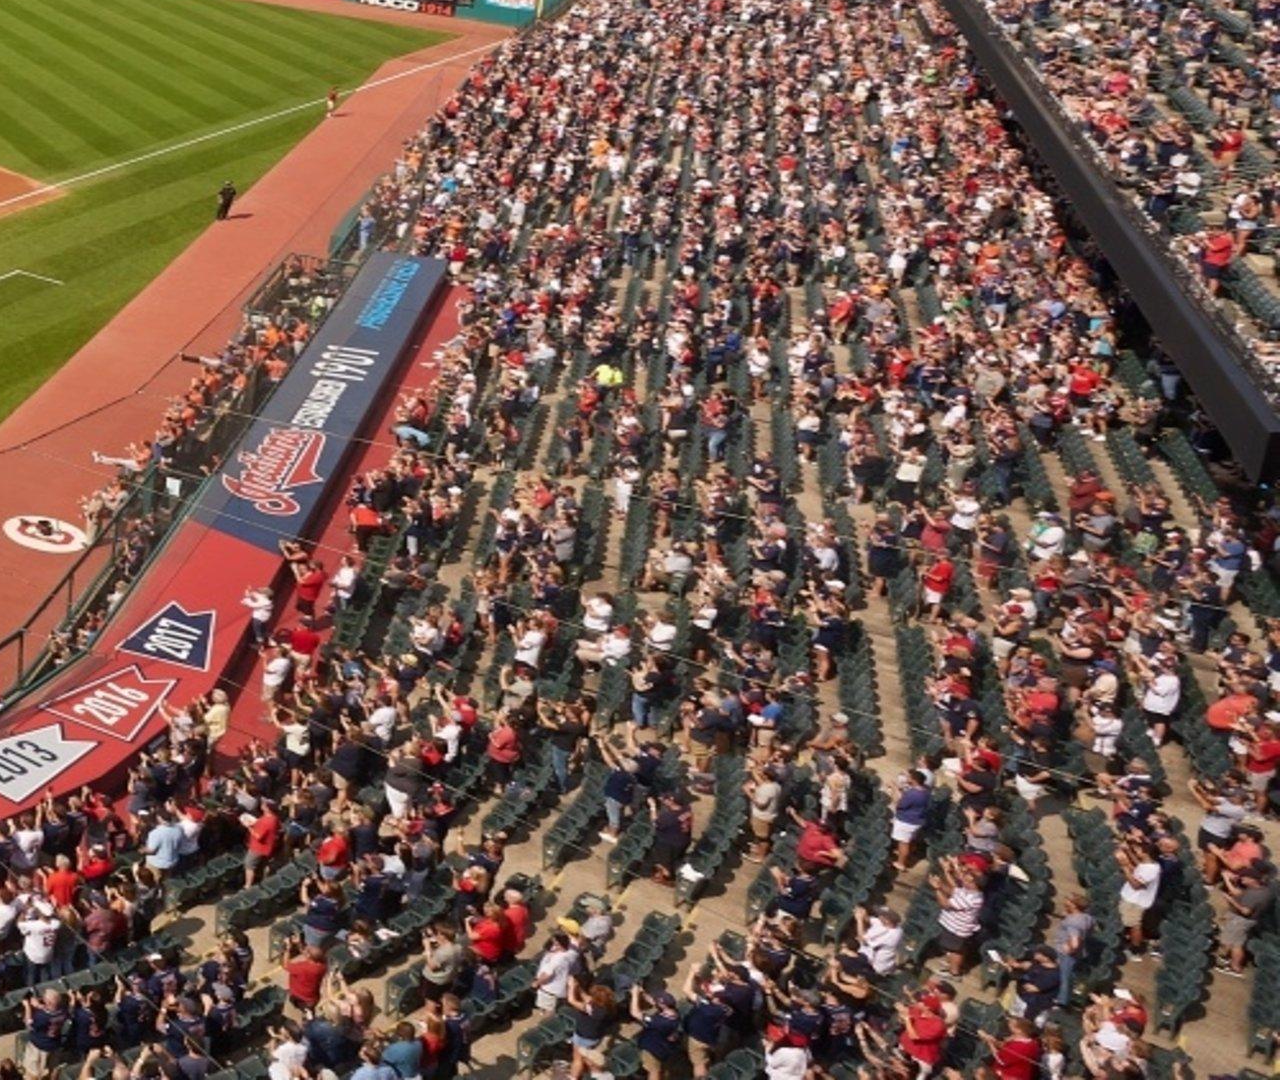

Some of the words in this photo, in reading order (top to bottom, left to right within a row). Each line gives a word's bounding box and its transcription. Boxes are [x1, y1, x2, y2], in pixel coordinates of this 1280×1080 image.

[310, 344, 381, 382] 1901
[222, 427, 326, 516] Indians
[143, 617, 204, 660] 2017
[72, 682, 150, 726] 2016
